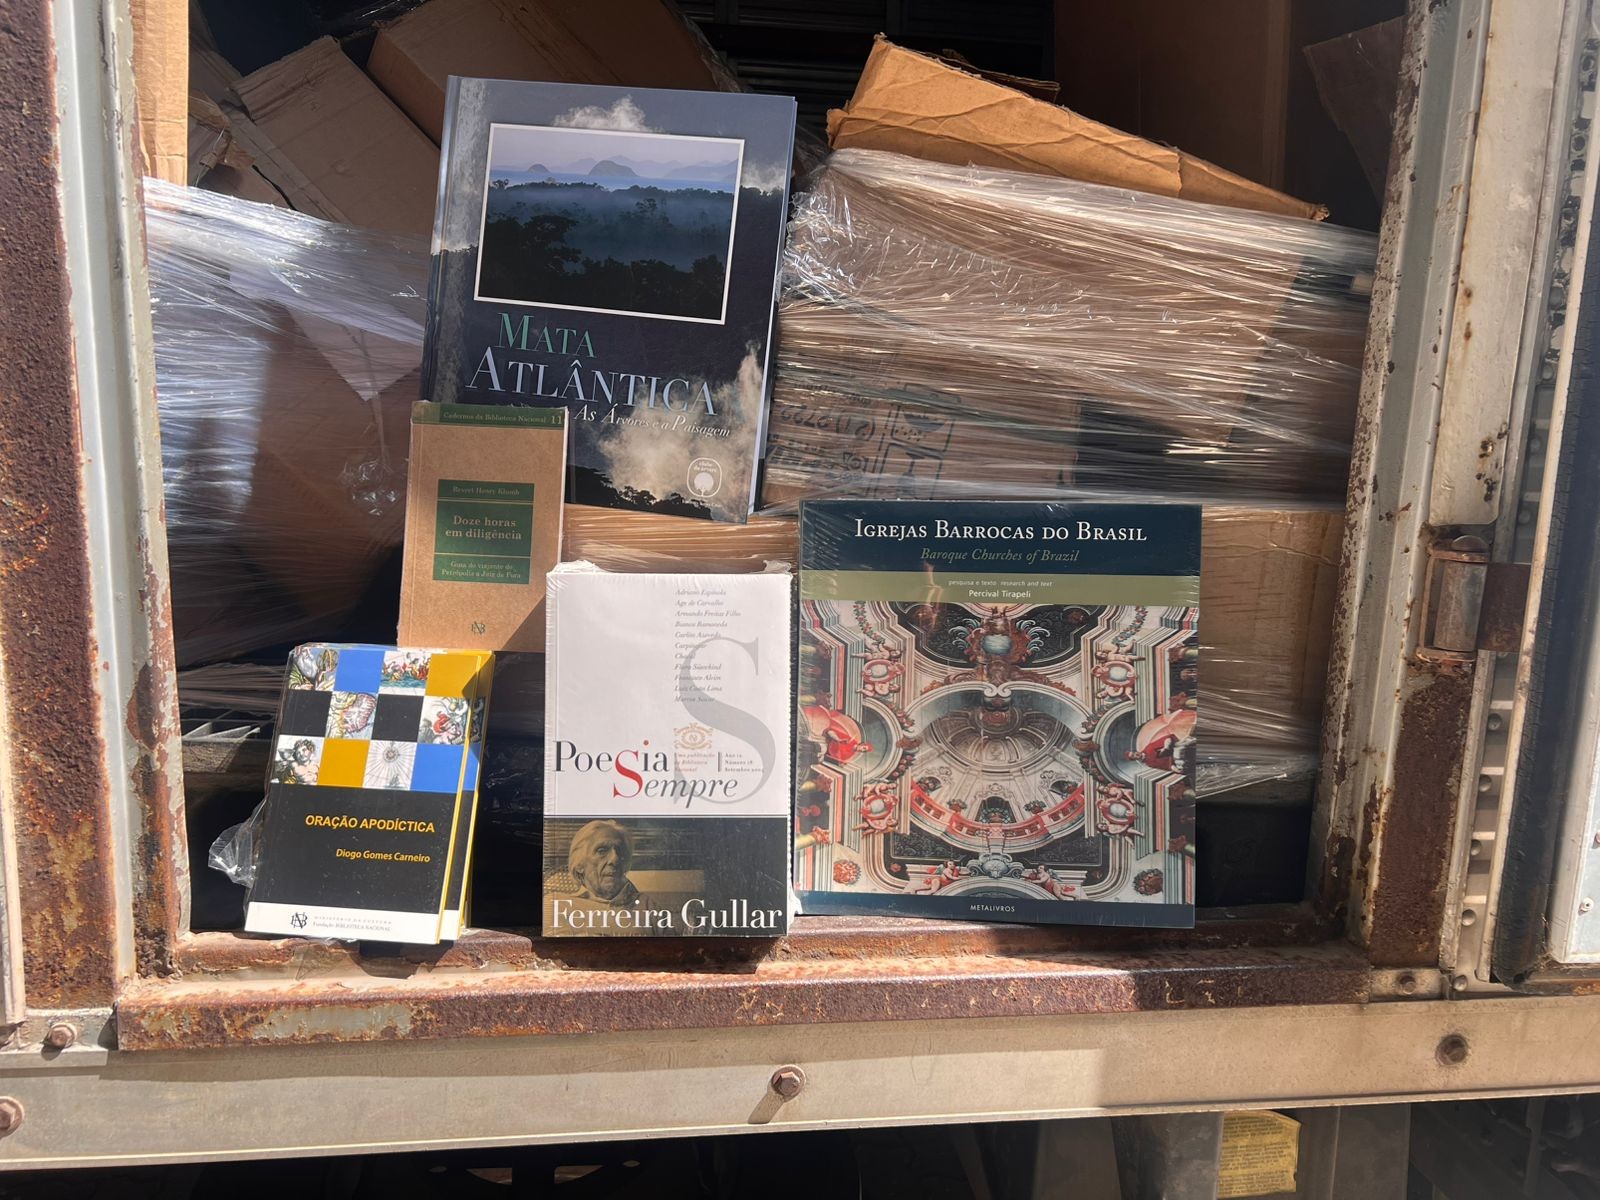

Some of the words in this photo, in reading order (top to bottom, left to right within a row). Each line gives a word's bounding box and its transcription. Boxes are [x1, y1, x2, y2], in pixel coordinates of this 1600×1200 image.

[494, 312, 598, 358] MATA
[466, 346, 718, 417] ATLÂNTICA
[443, 411, 474, 420] Cadernos
[484, 413, 517, 421] Biblioteca
[518, 415, 546, 423] Nacional
[551, 415, 562, 425] 11
[573, 404, 597, 421] As
[600, 403, 650, 427] Árvores
[661, 422, 668, 430] a
[672, 415, 731, 438] Paisagem
[453, 515, 481, 526] Doze
[484, 517, 517, 528] horas
[854, 518, 928, 541] IGREJAS
[934, 519, 1035, 540] BARROCAS
[1042, 526, 1069, 540] DO
[1076, 521, 1147, 541] BRASIL
[445, 529, 462, 537] em
[465, 528, 522, 541] diligência
[920, 547, 968, 564] Baroque
[971, 548, 1023, 561] Churches
[1026, 549, 1041, 565] of
[1041, 549, 1080, 562] Brazil
[968, 590, 999, 598] Percival
[1001, 590, 1031, 599] Tirapeli
[305, 814, 358, 830] ORAÇÃO
[360, 817, 435, 833] APODÍCTICA
[335, 848, 362, 860] Diogo
[363, 849, 393, 861] Gomes
[393, 852, 431, 863] Carneiro
[552, 899, 674, 929] Ferreira
[681, 898, 783, 929] Gullar
[969, 904, 1016, 913] METALIVROS
